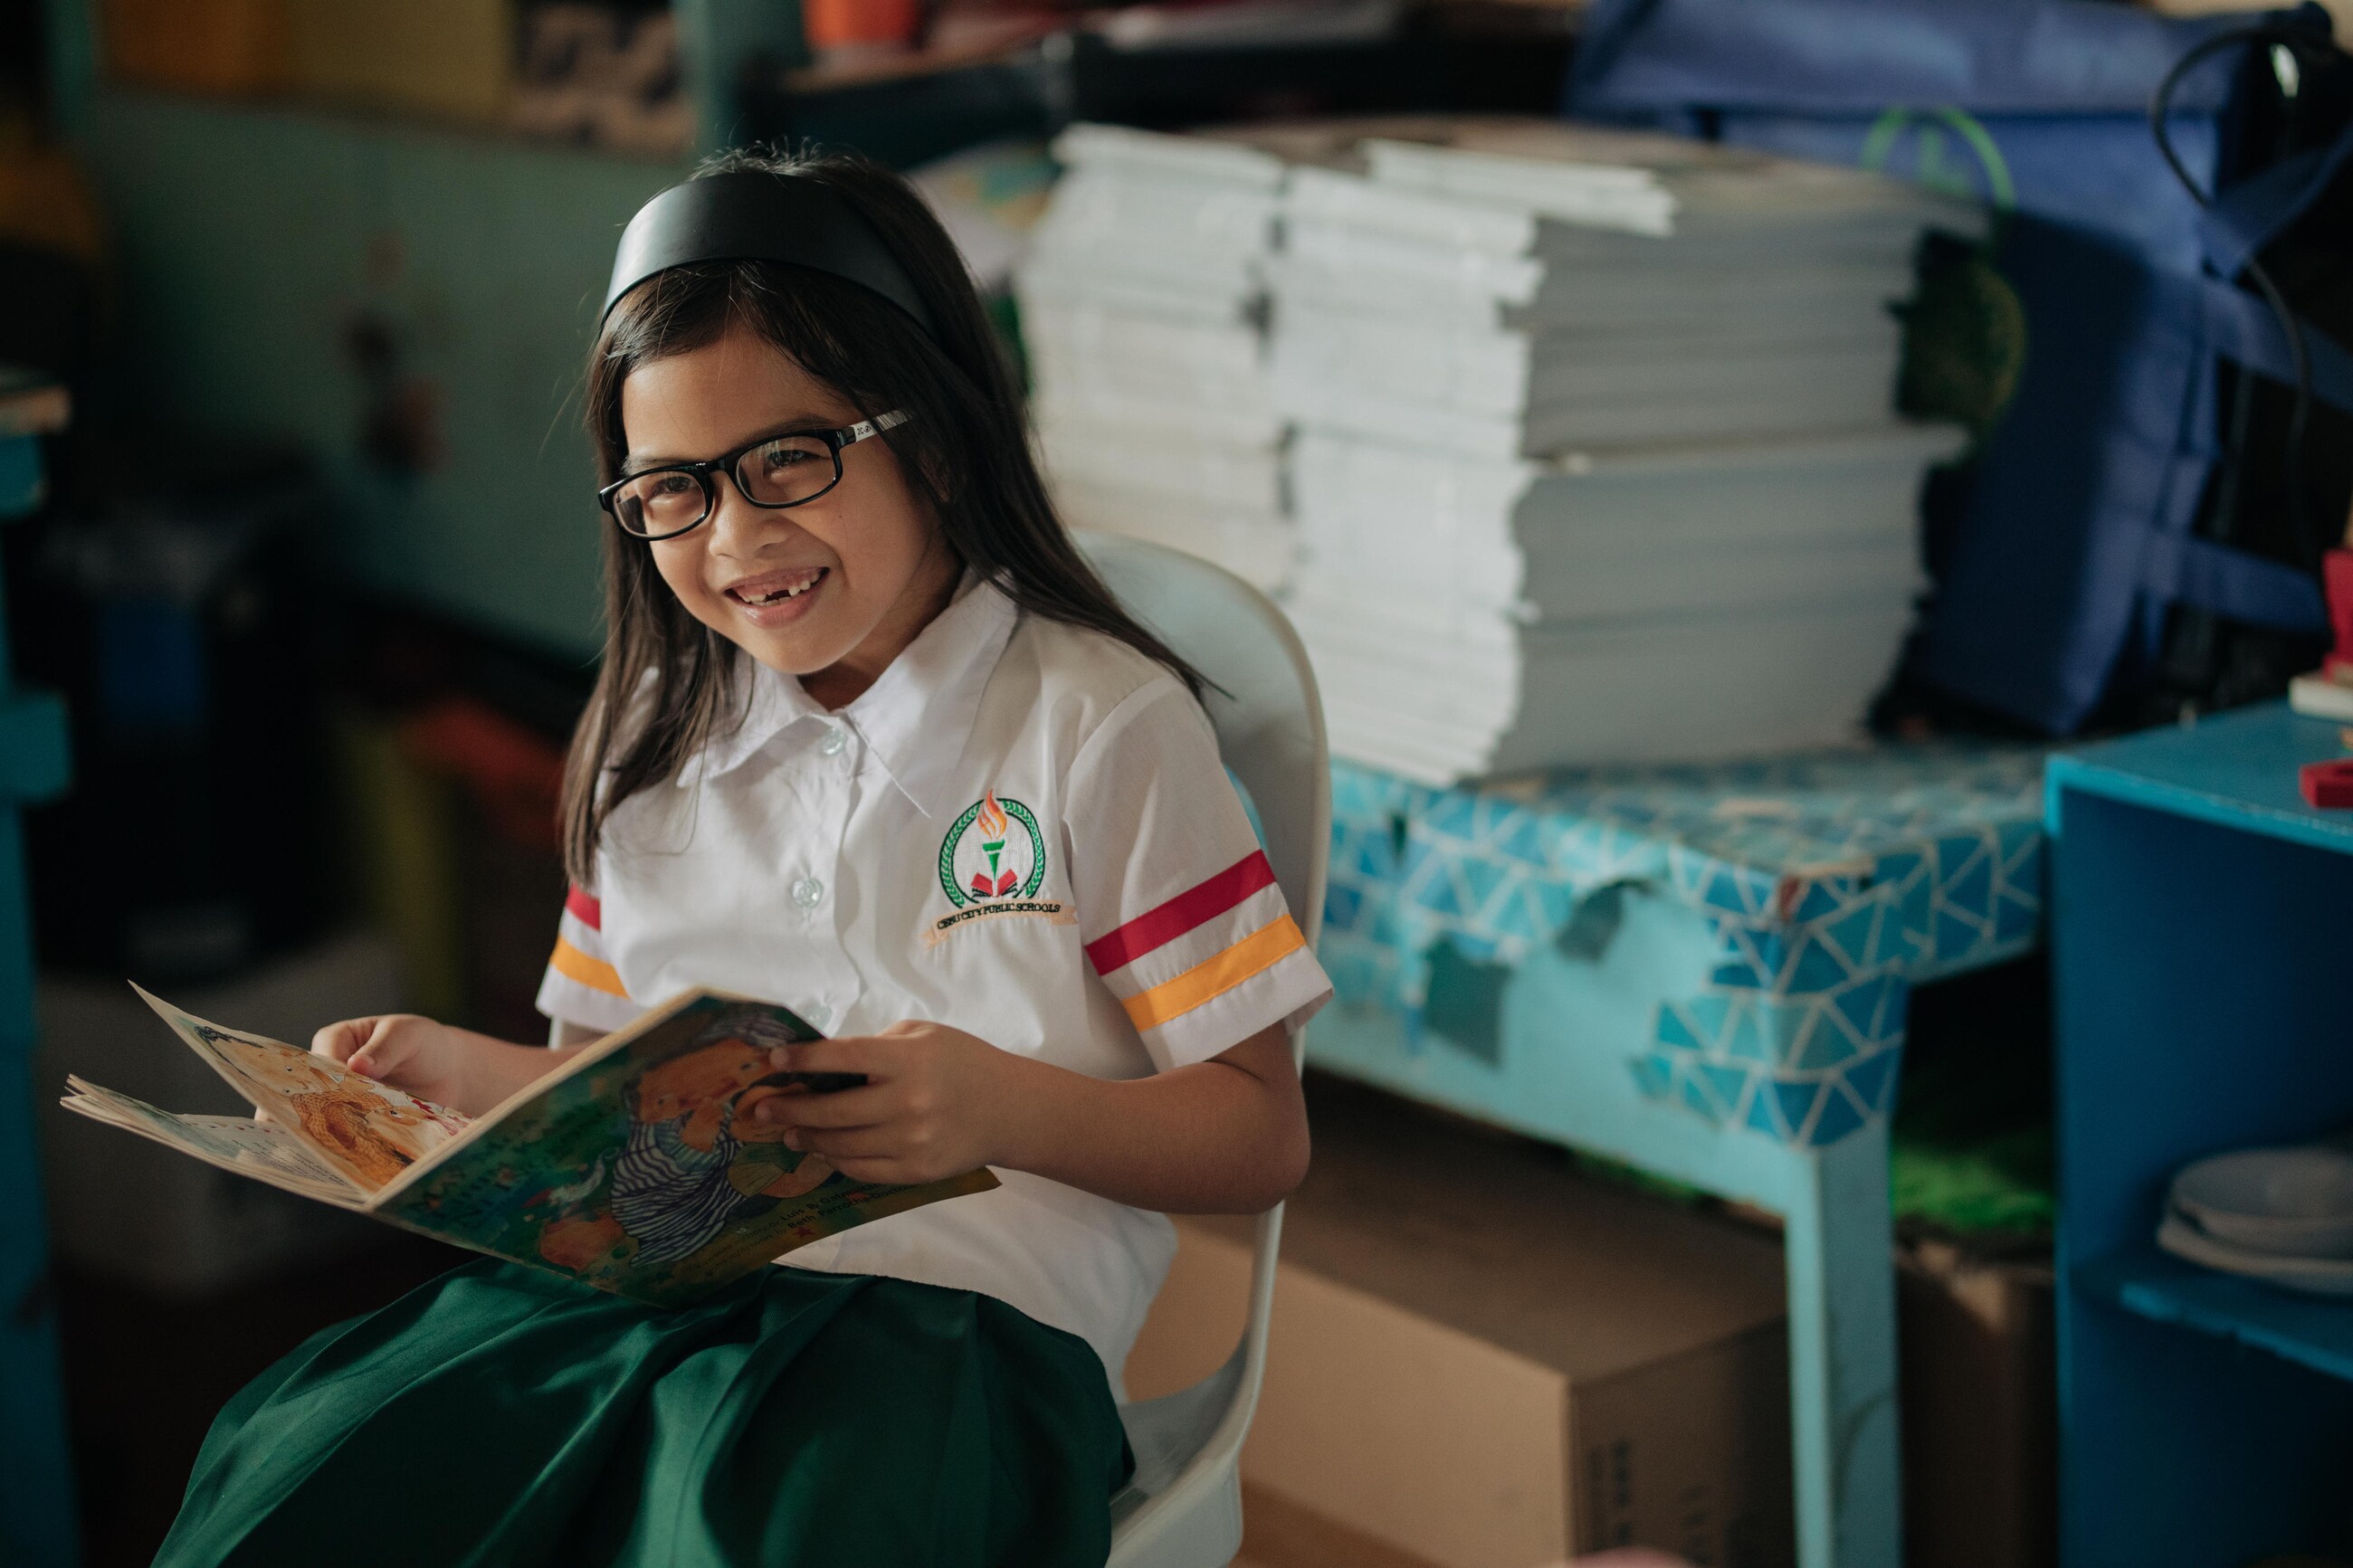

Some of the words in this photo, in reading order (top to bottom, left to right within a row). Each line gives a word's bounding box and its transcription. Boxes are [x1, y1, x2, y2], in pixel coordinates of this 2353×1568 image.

[937, 913, 960, 929] CEBU
[960, 908, 984, 920] CITY
[983, 903, 1015, 915] PUBLIC
[1015, 903, 1061, 913] SCHOOLS
[779, 1207, 805, 1221] Luis
[787, 1214, 816, 1229] Beth
